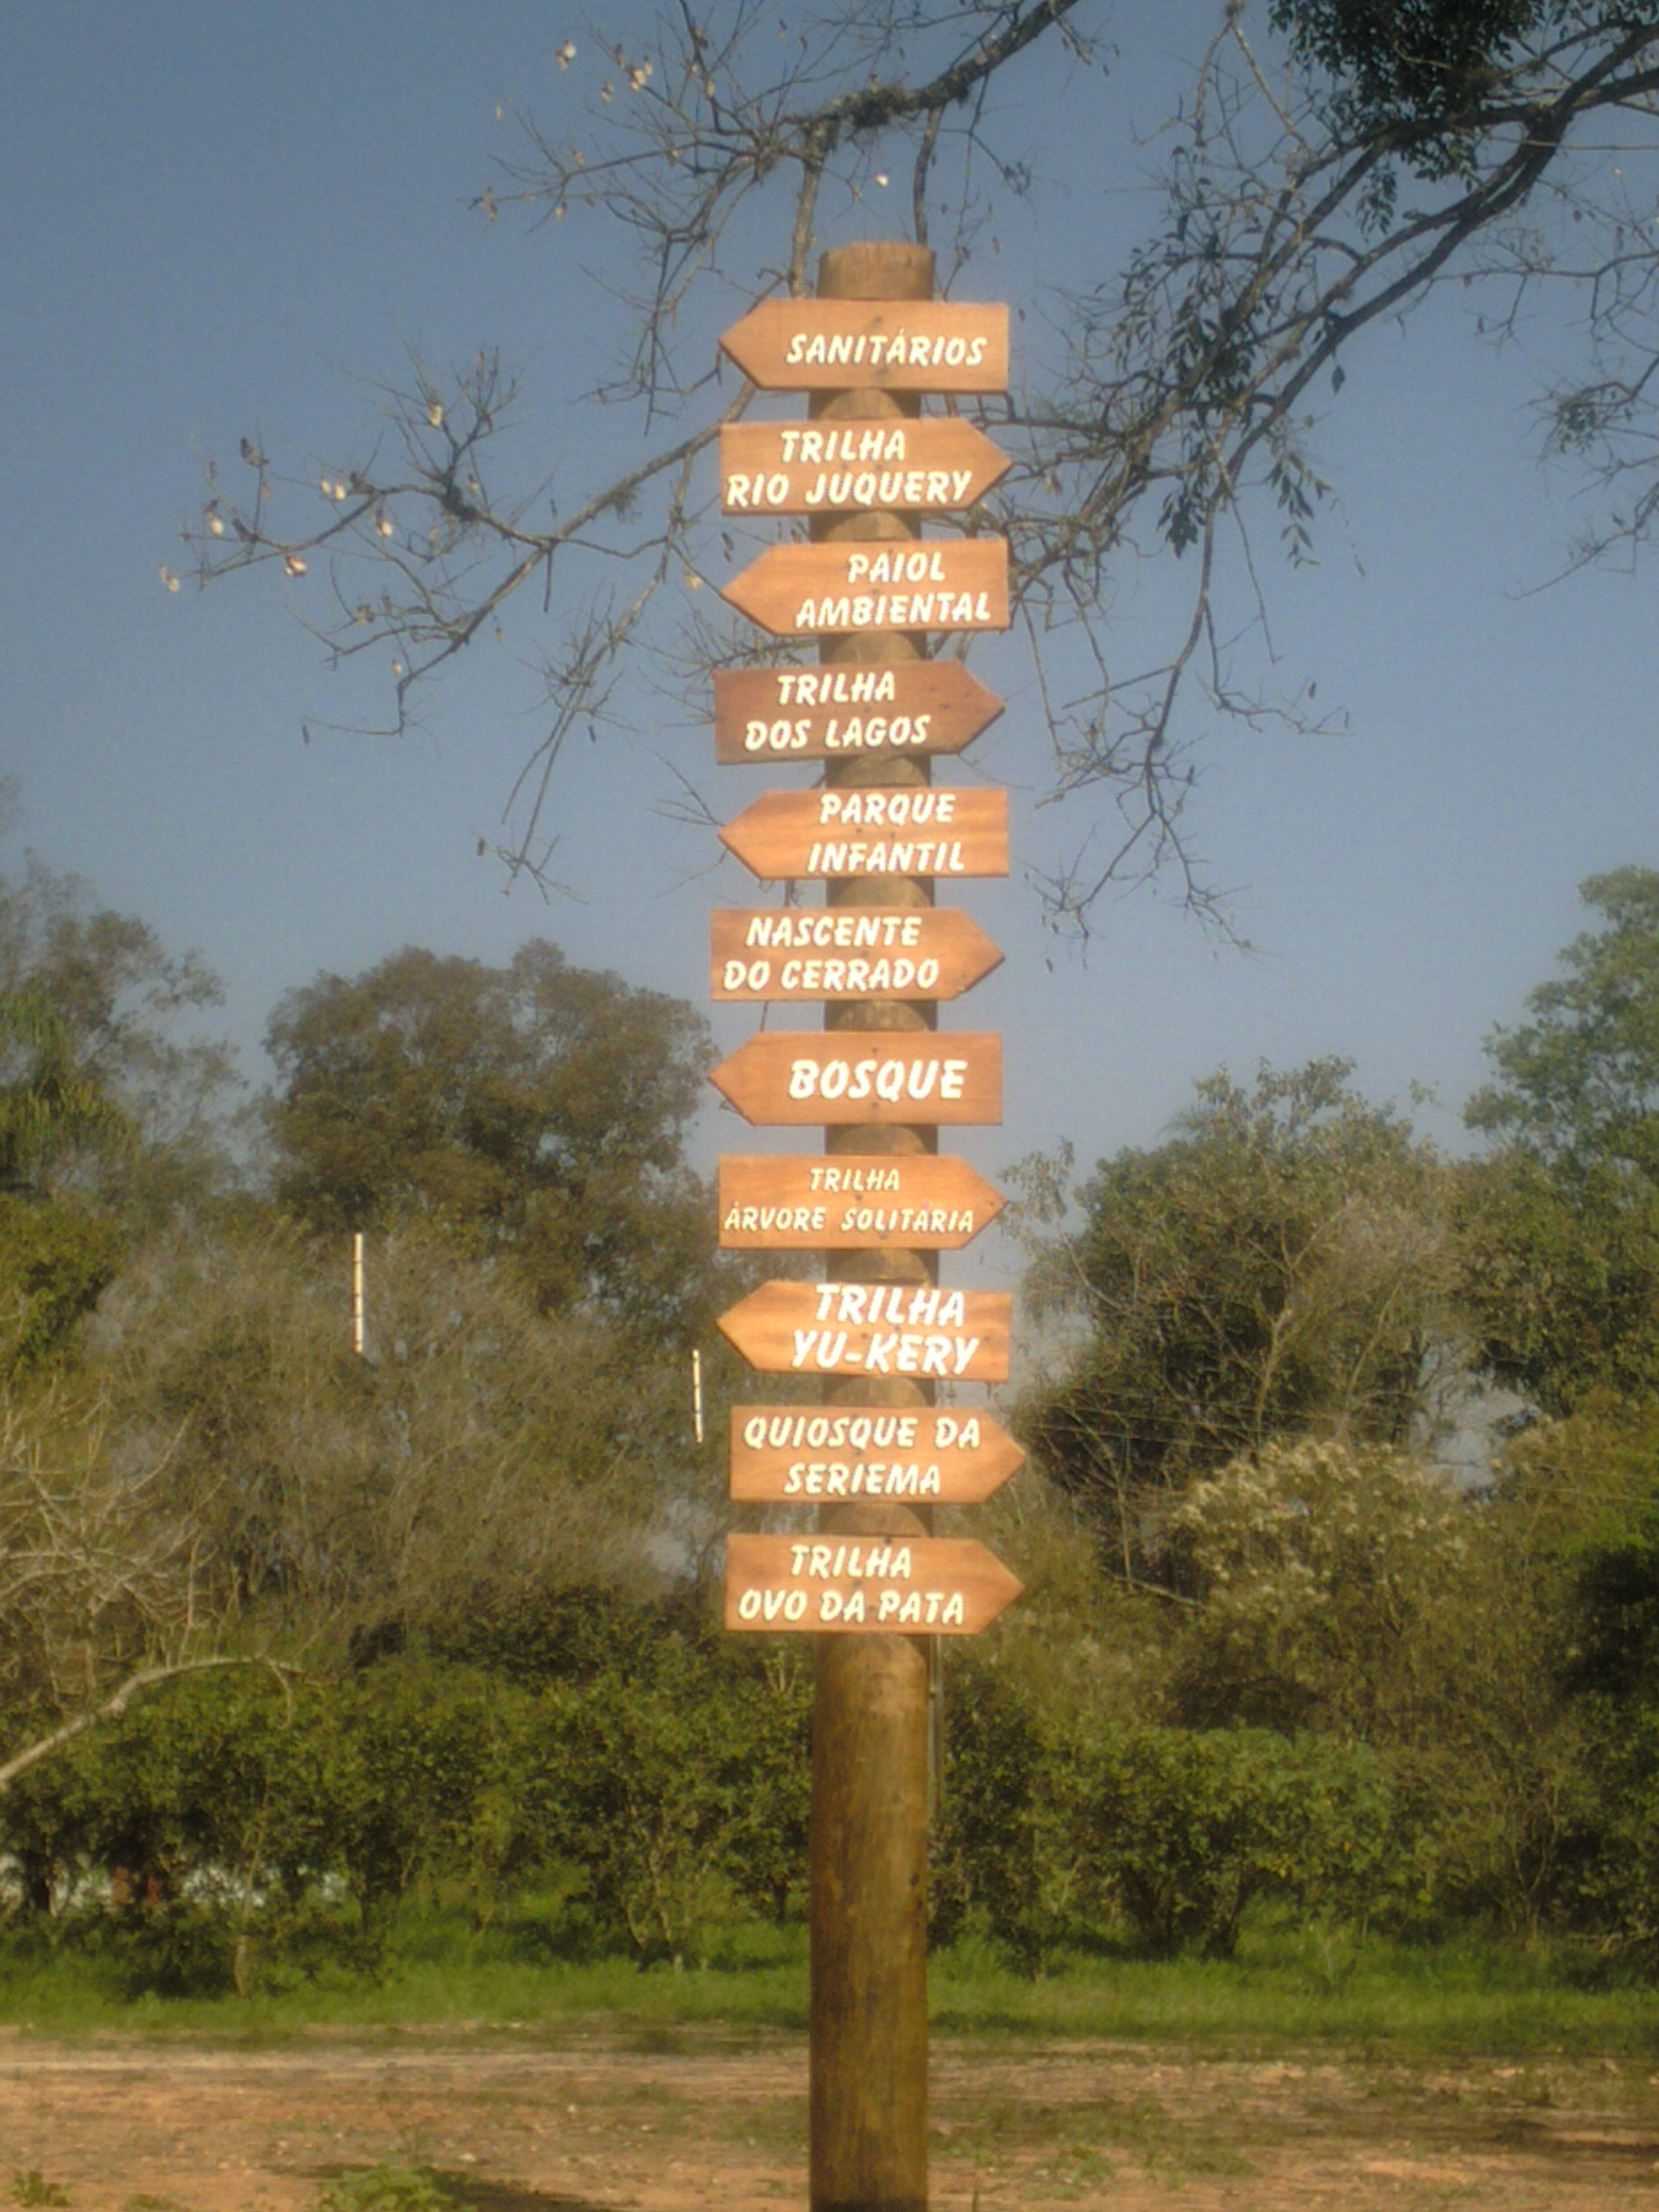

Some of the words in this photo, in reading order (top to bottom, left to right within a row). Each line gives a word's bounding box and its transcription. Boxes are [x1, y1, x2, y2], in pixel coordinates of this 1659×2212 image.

[786, 329, 986, 366] SANITÁRIOS
[780, 430, 905, 463] TRILHA
[726, 474, 789, 507] RIO
[805, 471, 972, 506] JUQUERY
[848, 552, 945, 583] PAIOL
[795, 592, 991, 628] AMBIENTAL
[777, 672, 895, 706] TRILHA
[745, 719, 811, 751] DOS
[825, 715, 930, 747] LAGOS
[820, 793, 957, 825] PARQUE
[806, 842, 964, 873] INFANTIL
[746, 916, 922, 947] NASCENTE
[724, 960, 770, 990] DO
[781, 959, 939, 991] CERRADO
[789, 1059, 968, 1102] BOSQUE
[810, 1168, 900, 1193] TRILHA
[724, 1202, 826, 1232] ÁRVORE
[815, 1284, 965, 1327] TRILHA
[791, 1329, 979, 1375] YU-KERY
[743, 1417, 918, 1450] QUIOSQUE
[934, 1418, 980, 1449] DA
[783, 1463, 941, 1496] SERIEMA
[790, 1545, 912, 1579] TRILHA
[738, 1589, 807, 1622] OVO
[820, 1591, 865, 1623] DA
[878, 1592, 963, 1625] PATA
